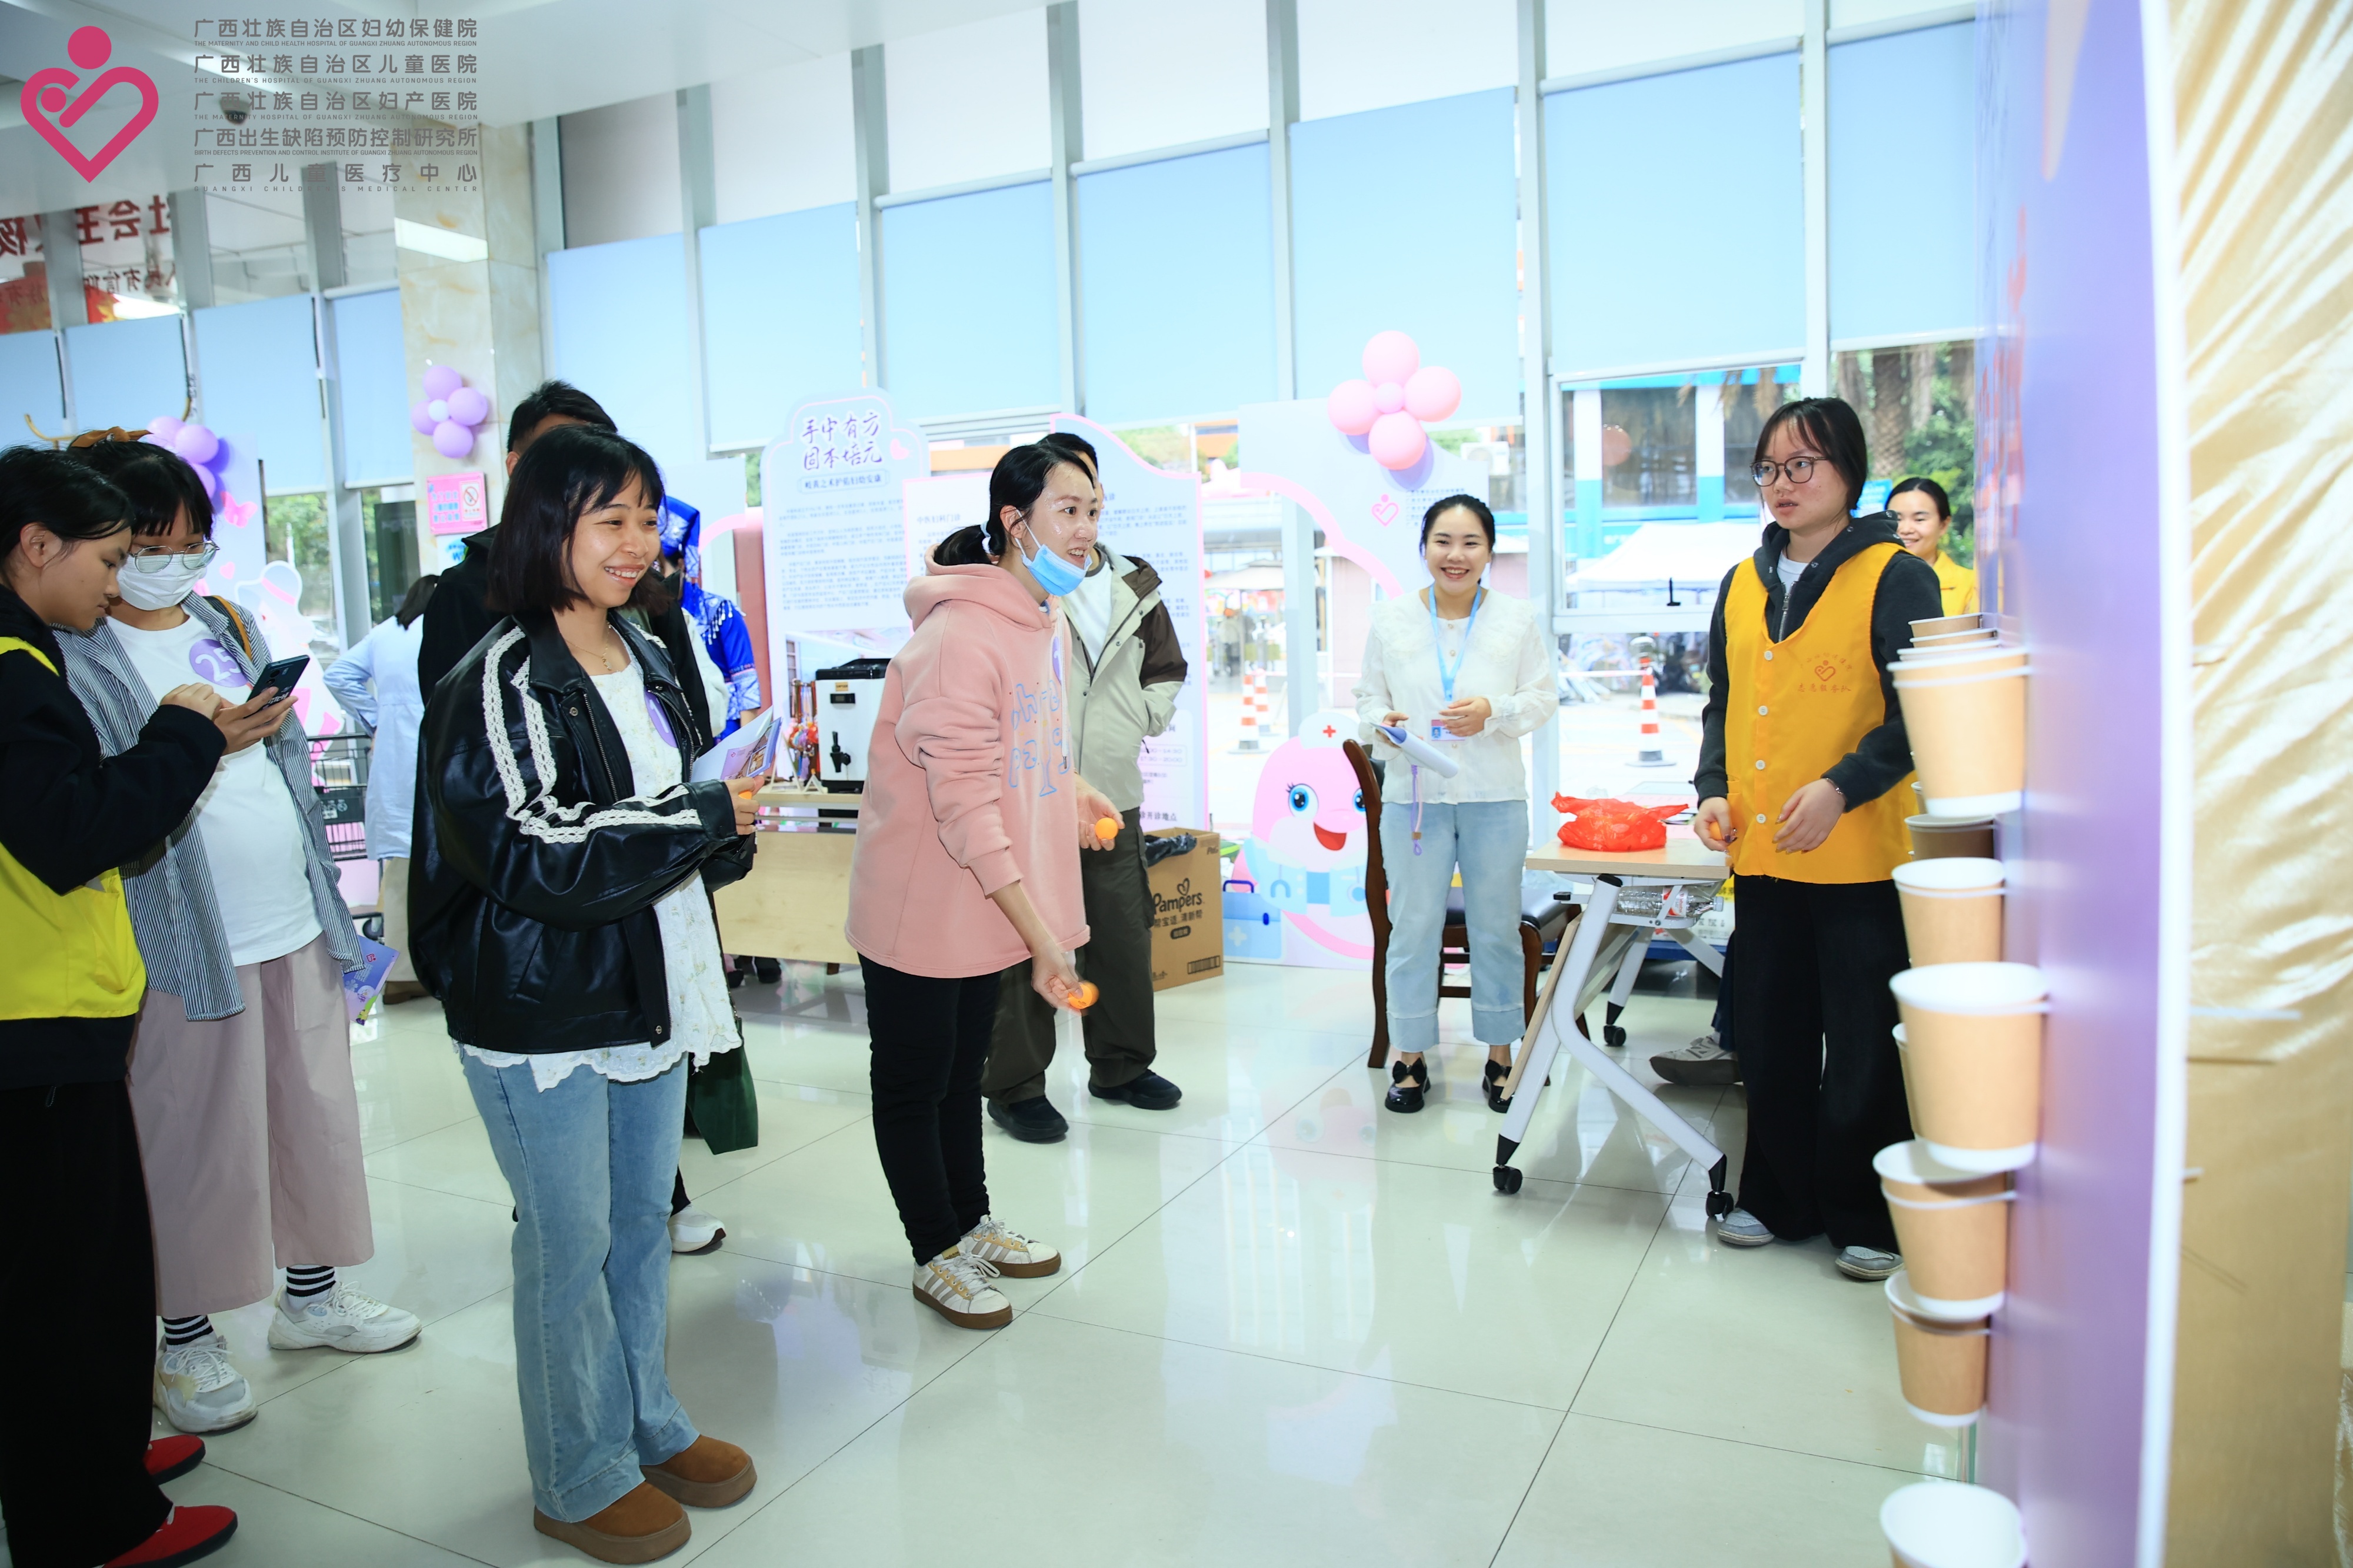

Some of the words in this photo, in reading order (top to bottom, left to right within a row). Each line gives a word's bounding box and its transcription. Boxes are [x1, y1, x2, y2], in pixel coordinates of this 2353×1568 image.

[802, 412, 879, 443] 手中有方
[804, 442, 882, 471] 固本培元
[195, 647, 241, 682] 25
[1153, 892, 1202, 915] Pampers
